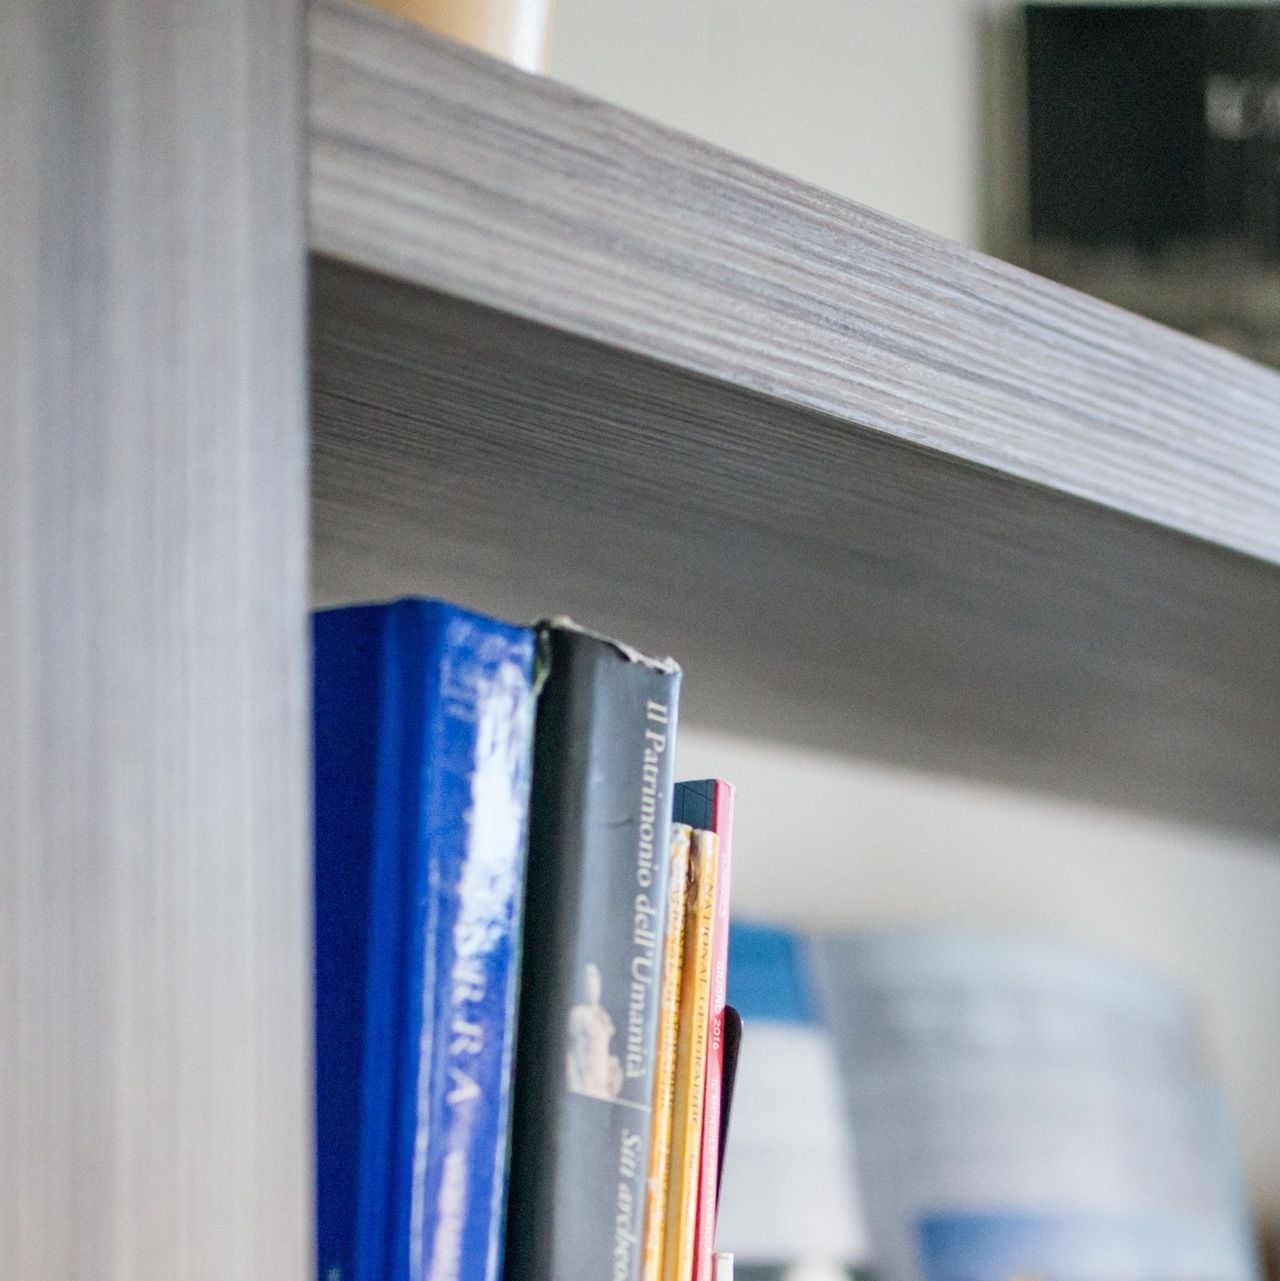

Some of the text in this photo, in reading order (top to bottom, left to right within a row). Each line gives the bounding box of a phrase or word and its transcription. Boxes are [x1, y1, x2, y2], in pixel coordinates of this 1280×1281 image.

[625, 699, 669, 1078] Il Patrimonio dell'Umanità
[691, 884, 714, 1122] NATIONAL GEOGRAPHIC
[712, 961, 723, 1050] GIUGNO 2016
[620, 1126, 642, 1179] Siti
